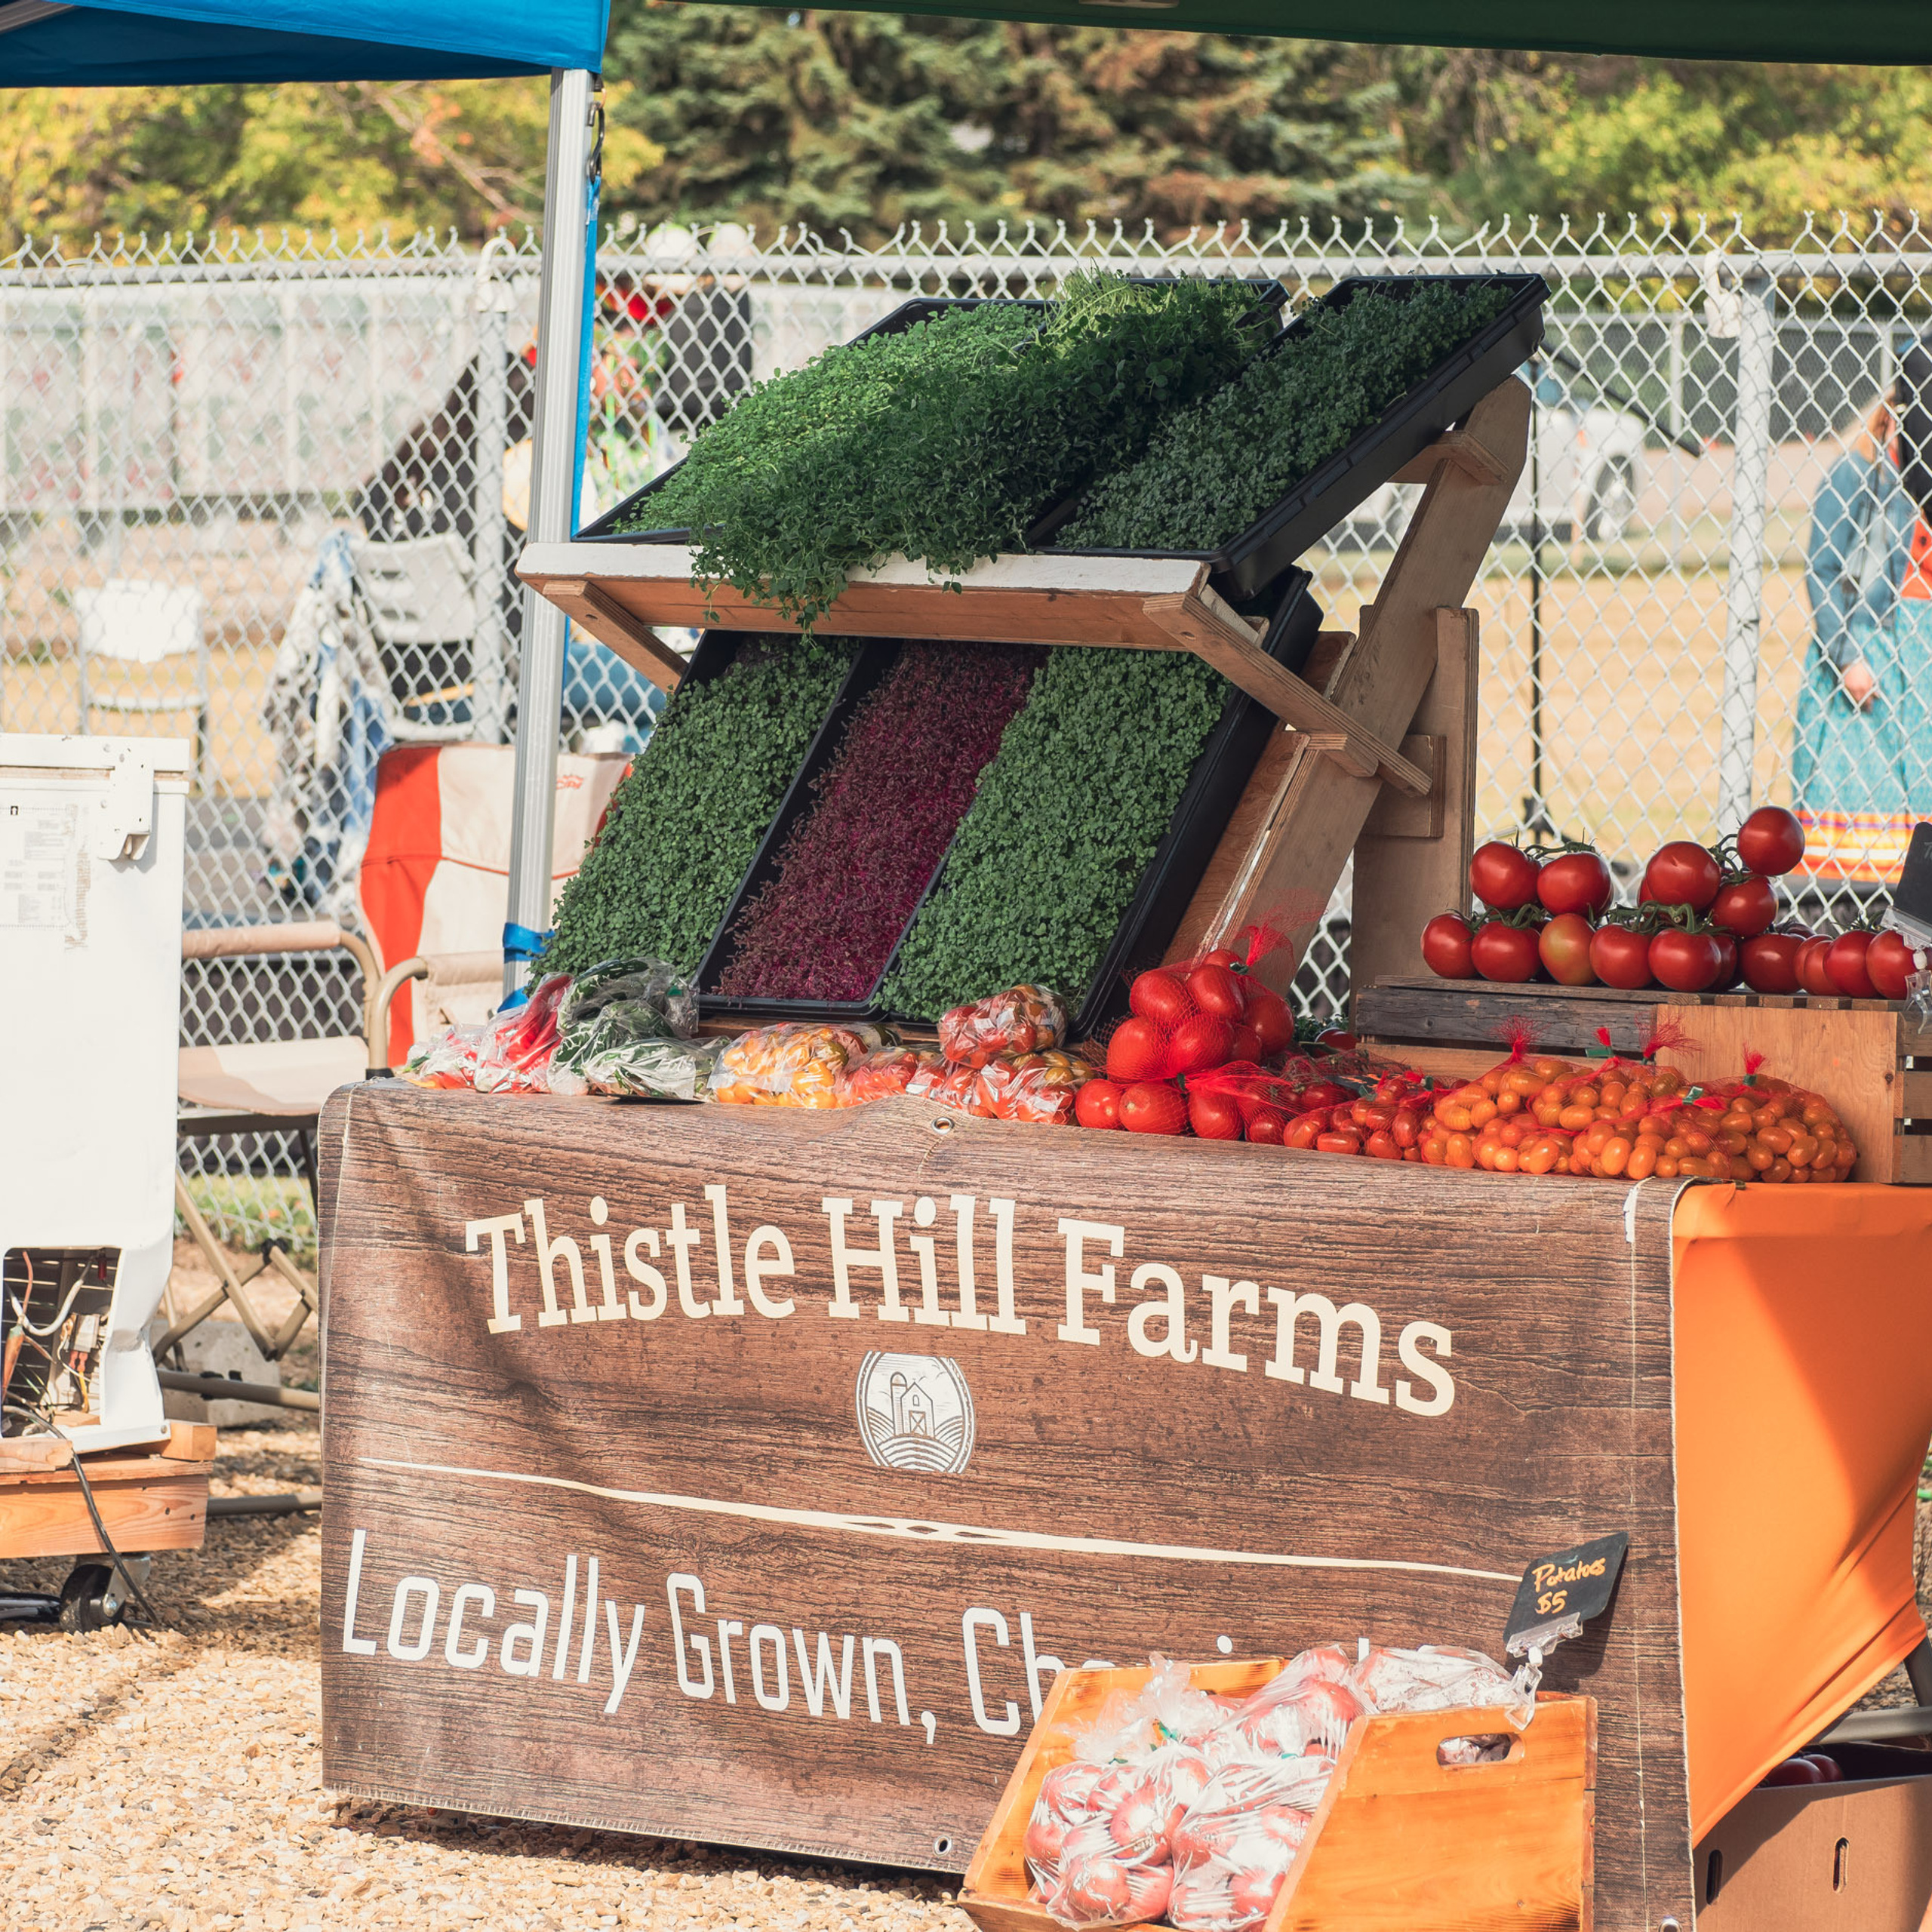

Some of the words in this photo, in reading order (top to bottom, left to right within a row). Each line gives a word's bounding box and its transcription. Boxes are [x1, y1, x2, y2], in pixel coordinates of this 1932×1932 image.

[465, 1184, 795, 1334] Thistle
[822, 1194, 1027, 1336] Hill
[1058, 1217, 1457, 1417] Farms
[343, 1529, 646, 1715] Locally
[666, 1573, 937, 1746] Grown,
[1534, 1589, 1568, 1615] $5
